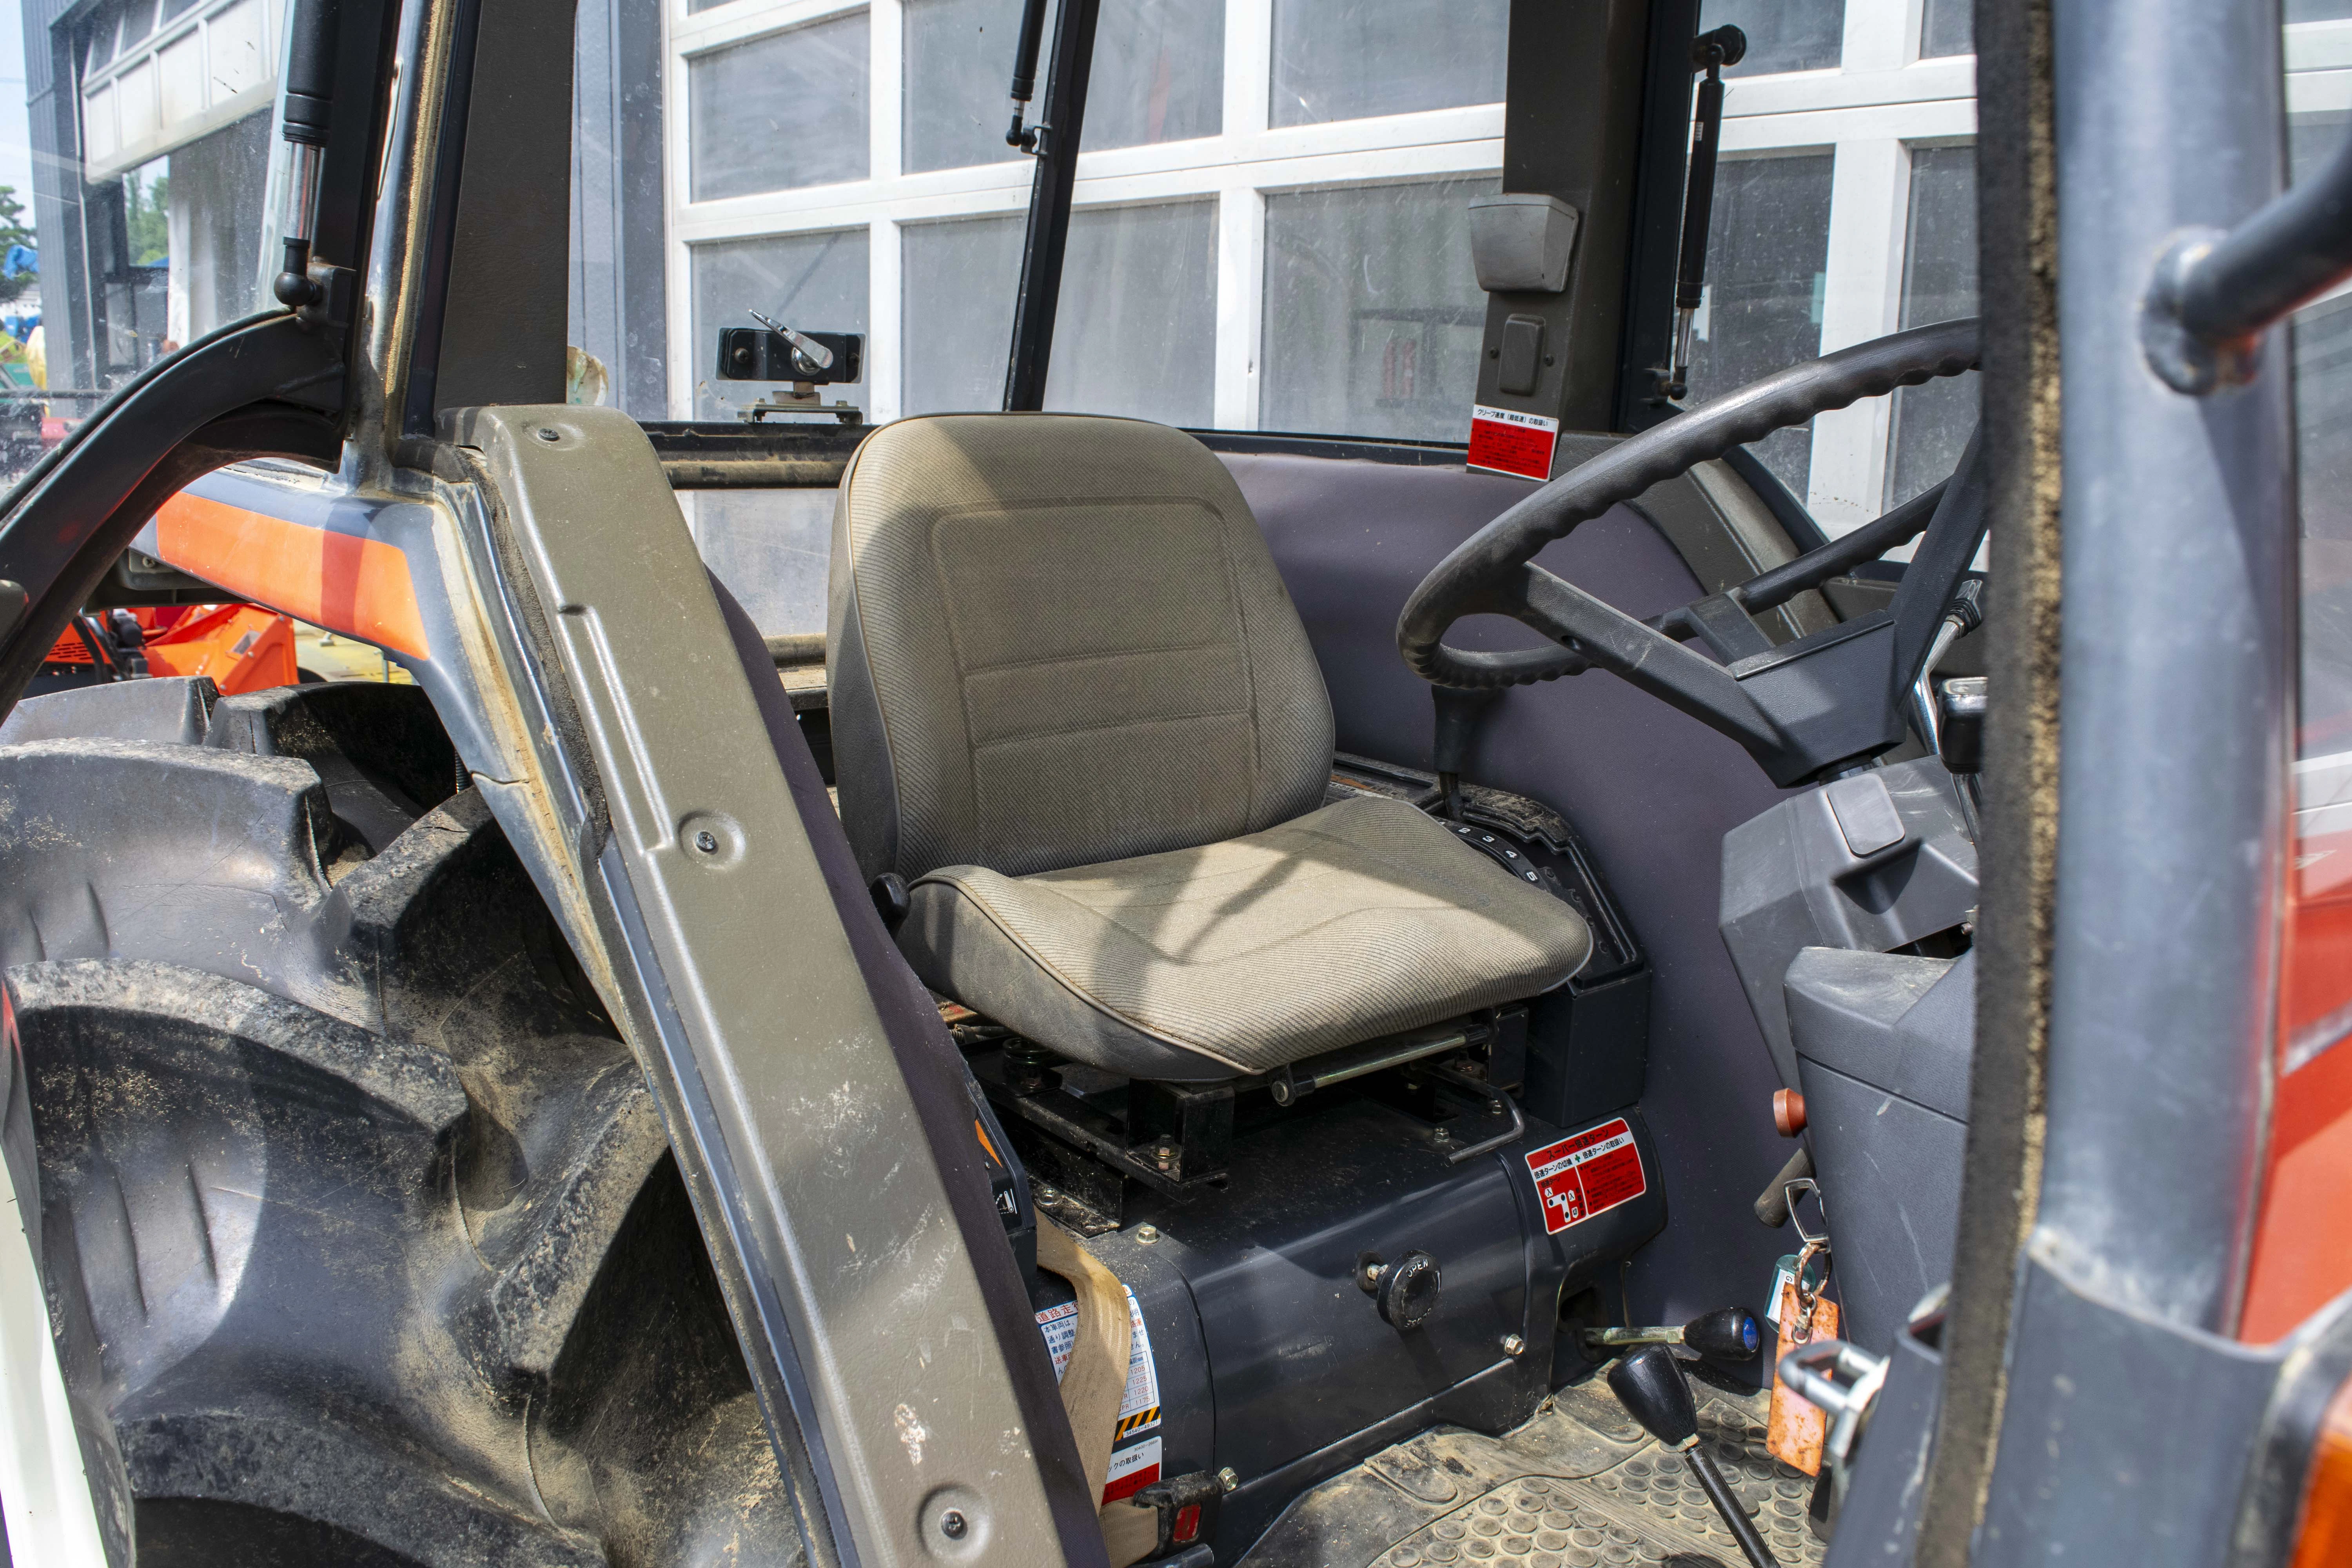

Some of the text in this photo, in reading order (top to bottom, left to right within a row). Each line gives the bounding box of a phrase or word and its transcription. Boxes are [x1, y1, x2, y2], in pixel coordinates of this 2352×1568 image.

[1505, 850, 1517, 858] 4
[1526, 871, 1536, 881] 5
[1546, 1129, 1609, 1160] スーパー倍速ターン
[1583, 1137, 1624, 1160] 倍速ターンの取扱い
[1406, 1258, 1428, 1278] OPEN
[1131, 1365, 1145, 1375] 1205
[1132, 1375, 1147, 1385] 1225
[1134, 1386, 1149, 1396] 1220
[1136, 1396, 1150, 1406] 1175
[1126, 1420, 1158, 1436] 34540-49321
